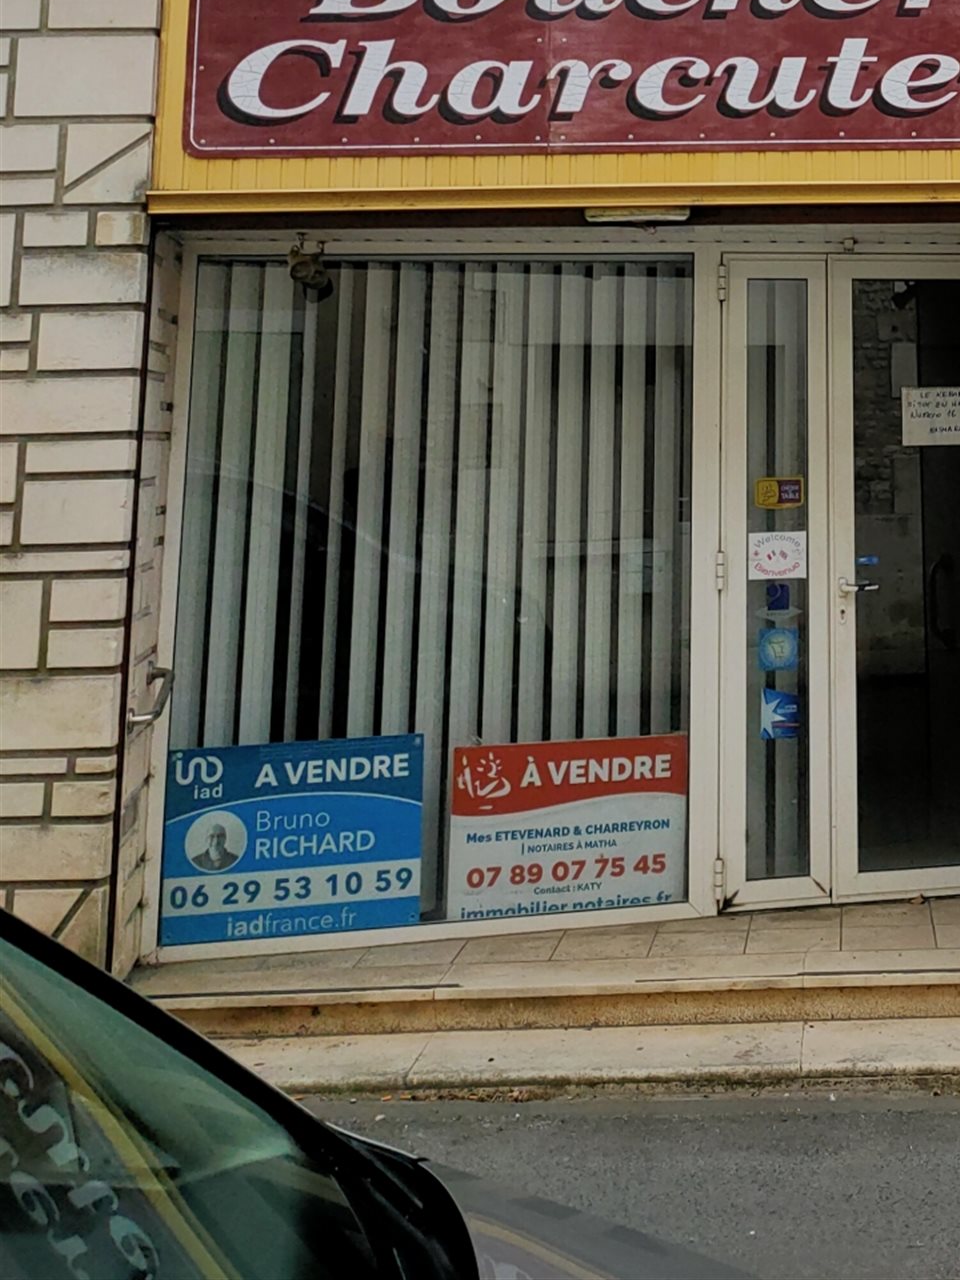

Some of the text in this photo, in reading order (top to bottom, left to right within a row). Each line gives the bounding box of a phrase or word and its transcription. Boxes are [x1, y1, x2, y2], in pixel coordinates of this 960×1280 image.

[753, 534, 801, 548] Welcome
[754, 561, 801, 576] Bienvenue
[254, 753, 410, 788] A VENDRE
[520, 754, 672, 788] À VENDRE
[194, 784, 223, 800] iad
[256, 810, 330, 832] Bruno
[466, 819, 671, 844] Mes ETEVENARD & CHARREYRON
[255, 830, 376, 860] RICHARD
[527, 841, 574, 855] NOTAIRES
[584, 838, 617, 850] MATHA
[466, 853, 667, 889] 07 89 07 75 45
[169, 867, 413, 910] 06 29 53 10 59
[533, 883, 571, 895] Contact
[577, 881, 603, 892] KATY
[226, 907, 357, 937] iadfrance.fr
